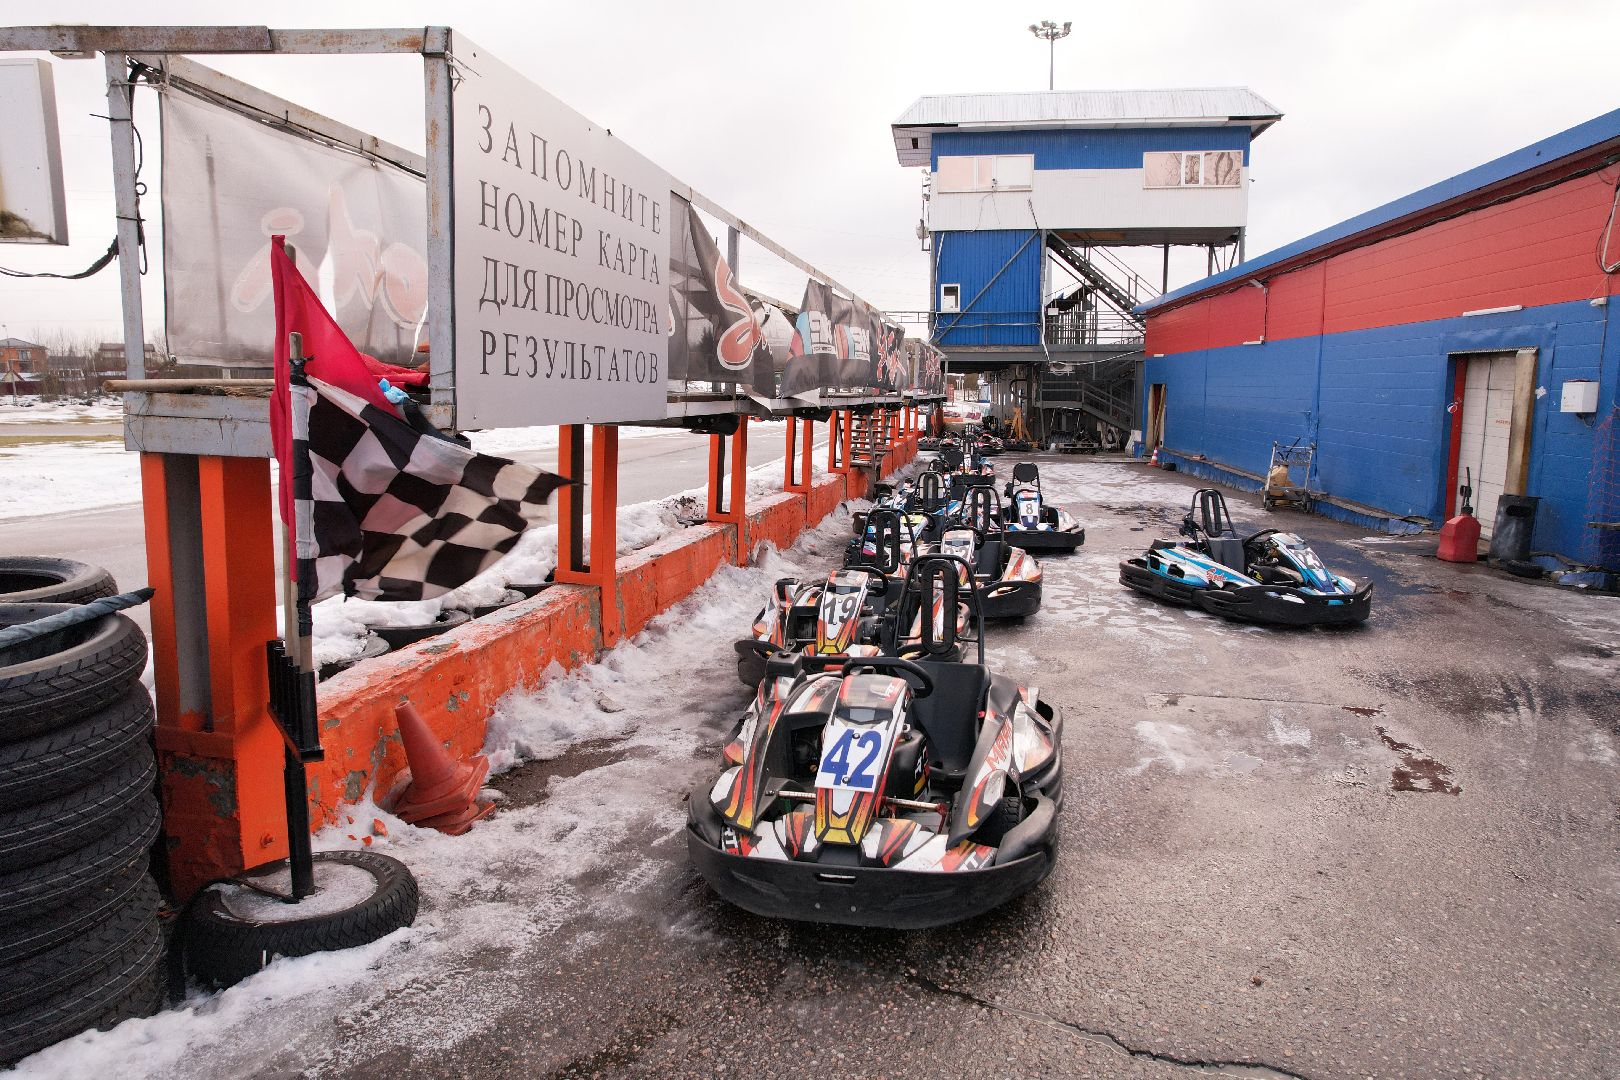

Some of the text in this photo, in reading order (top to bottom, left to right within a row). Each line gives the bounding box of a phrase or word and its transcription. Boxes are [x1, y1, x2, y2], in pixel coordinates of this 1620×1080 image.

[478, 104, 661, 234] ЗАПОМНИТЕ
[479, 180, 660, 284] НОМЕР КАРТА
[479, 256, 538, 316] ДЛЯ
[545, 273, 659, 335] ПРОСМОТРА
[480, 330, 658, 384] РЕЗУЛЬТАТОВ
[1025, 503, 1034, 515] 8
[824, 596, 857, 624] 19
[821, 728, 882, 789] 42
